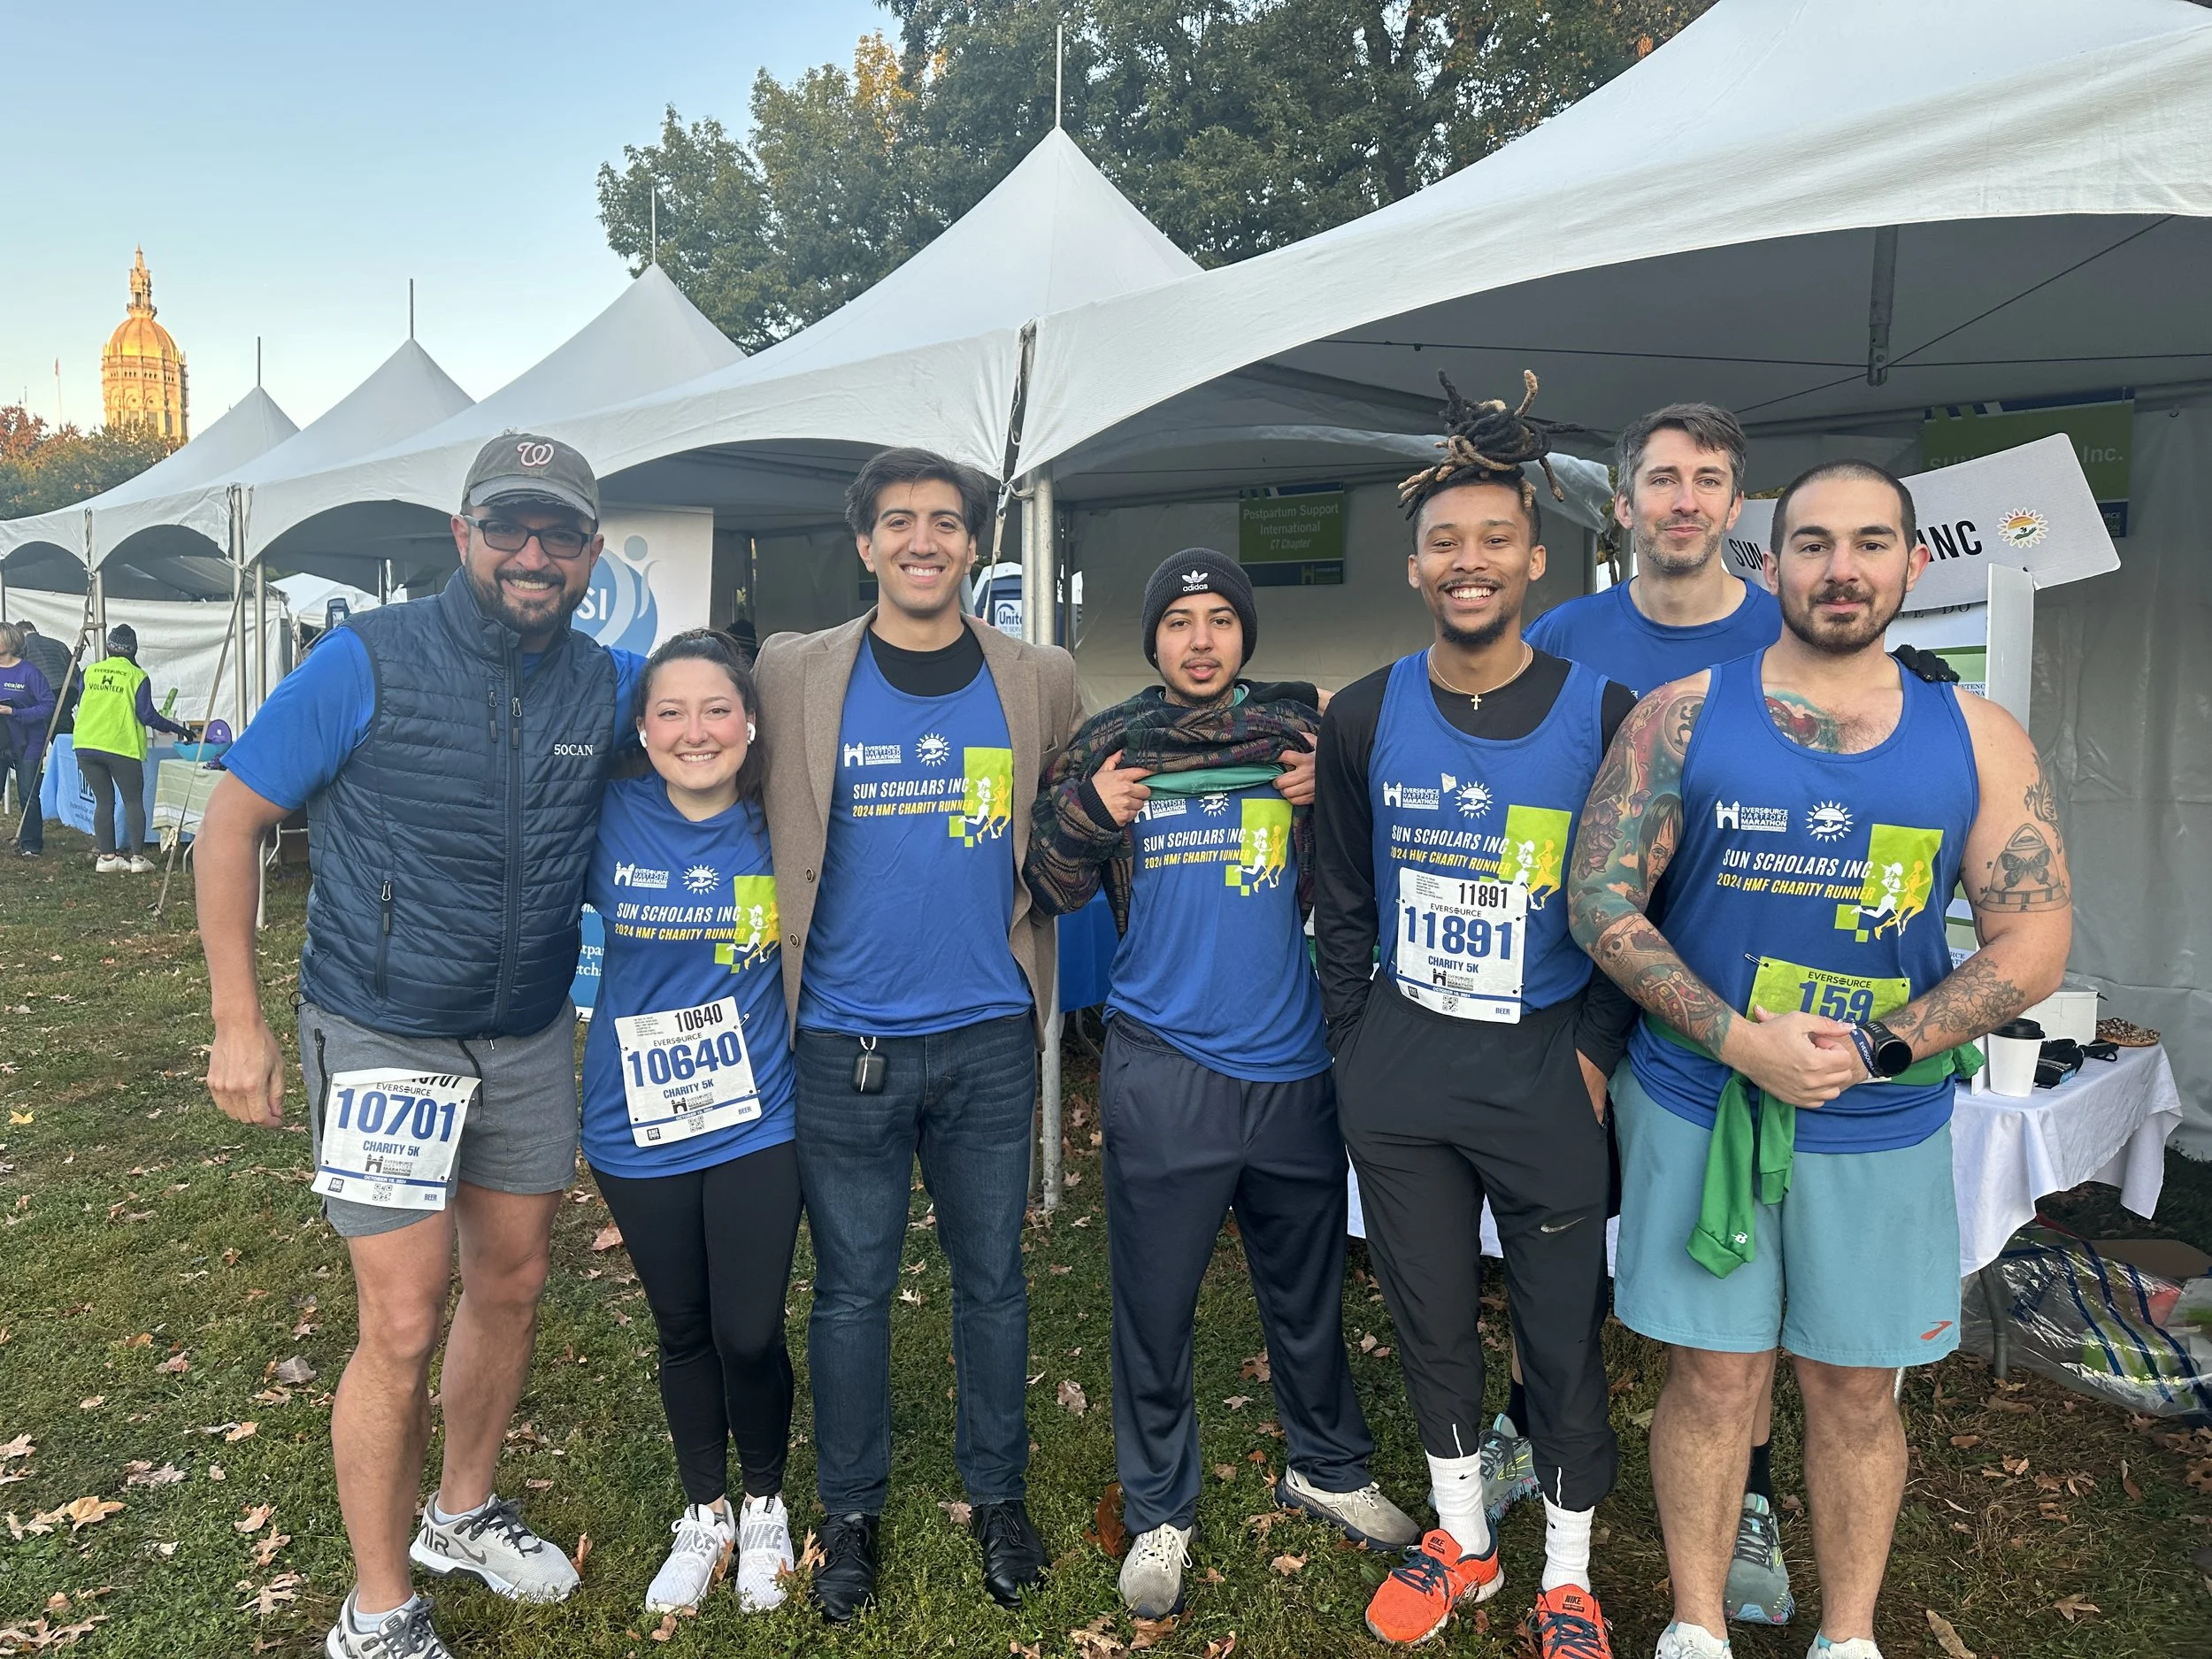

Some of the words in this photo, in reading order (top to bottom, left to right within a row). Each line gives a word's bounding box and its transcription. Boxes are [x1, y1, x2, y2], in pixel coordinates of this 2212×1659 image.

[2082, 445, 2124, 465] Inc.
[1243, 507, 1296, 520] Postpartum
[1299, 503, 1339, 517] Support
[1260, 520, 1321, 535] International
[1270, 539, 1280, 549] CT
[1281, 538, 1311, 550] Chapter
[1916, 520, 1982, 563] INC
[1728, 538, 1763, 571] SUN
[88, 683, 125, 694] VOLUNTEER
[853, 783, 878, 800] SUN
[879, 779, 946, 798] SCHOLARS
[947, 777, 973, 794] INC.
[852, 804, 874, 818] 2024
[875, 803, 896, 816] HMF
[898, 801, 937, 815] CHARITY
[938, 799, 974, 812] RUNNER
[1152, 804, 1187, 814] MARATHON
[1740, 806, 1789, 816] EVERSOURCE
[1740, 813, 1788, 822] HARTFORD
[1740, 818, 1787, 827] MARATHON
[1144, 834, 1164, 852] SUN
[1167, 828, 1225, 848] SCHOLARS
[1226, 827, 1250, 843] INC.
[1392, 825, 1412, 841] SUN
[1414, 828, 1482, 850] SCHOLARS
[1482, 835, 1512, 856] INC.
[1183, 850, 1219, 864] CHARITY
[1409, 849, 1427, 864] HMF
[1429, 851, 1469, 868] CHARITY
[1469, 856, 1512, 875] RUNNER
[1723, 849, 1751, 869] SUN
[1753, 852, 1839, 878] SCHOLARS
[1840, 859, 1877, 879] INC.
[1459, 882, 1508, 909] 11891
[1717, 872, 1742, 889] 2024
[1742, 878, 1770, 892] HMF
[1770, 879, 1824, 897] CHARITY
[1824, 884, 1877, 901] RUNNER
[617, 902, 640, 920] SUN
[641, 904, 715, 922] SCHOLARS
[716, 905, 745, 922] INC.
[1430, 902, 1482, 918] EVERSOURCE
[615, 923, 634, 936] 2024
[635, 926, 657, 939] HMF
[658, 927, 703, 941] CHARITY
[704, 928, 746, 940] RUNNER
[1404, 905, 1513, 961] 11891
[1428, 955, 1464, 972] CHARITY
[1466, 963, 1479, 973] 5K
[1808, 971, 1872, 989] EVERSOURCE
[1799, 980, 1874, 1027] 159
[674, 1002, 723, 1033] 10640
[653, 1032, 703, 1047] EVERSOURCE
[627, 1031, 742, 1087] 10640
[376, 1082, 432, 1097] EVERSOURCE
[664, 1083, 699, 1099] CHARITY
[702, 1079, 714, 1089] 5K
[336, 1087, 457, 1142] 10701
[738, 1106, 752, 1115] BEER
[363, 1140, 406, 1156] CHARITY
[407, 1145, 420, 1157] 5K
[743, 1524, 784, 1551] NIKE
[1430, 1536, 1446, 1547] NIKE
[1564, 1594, 1582, 1605] NIKE
